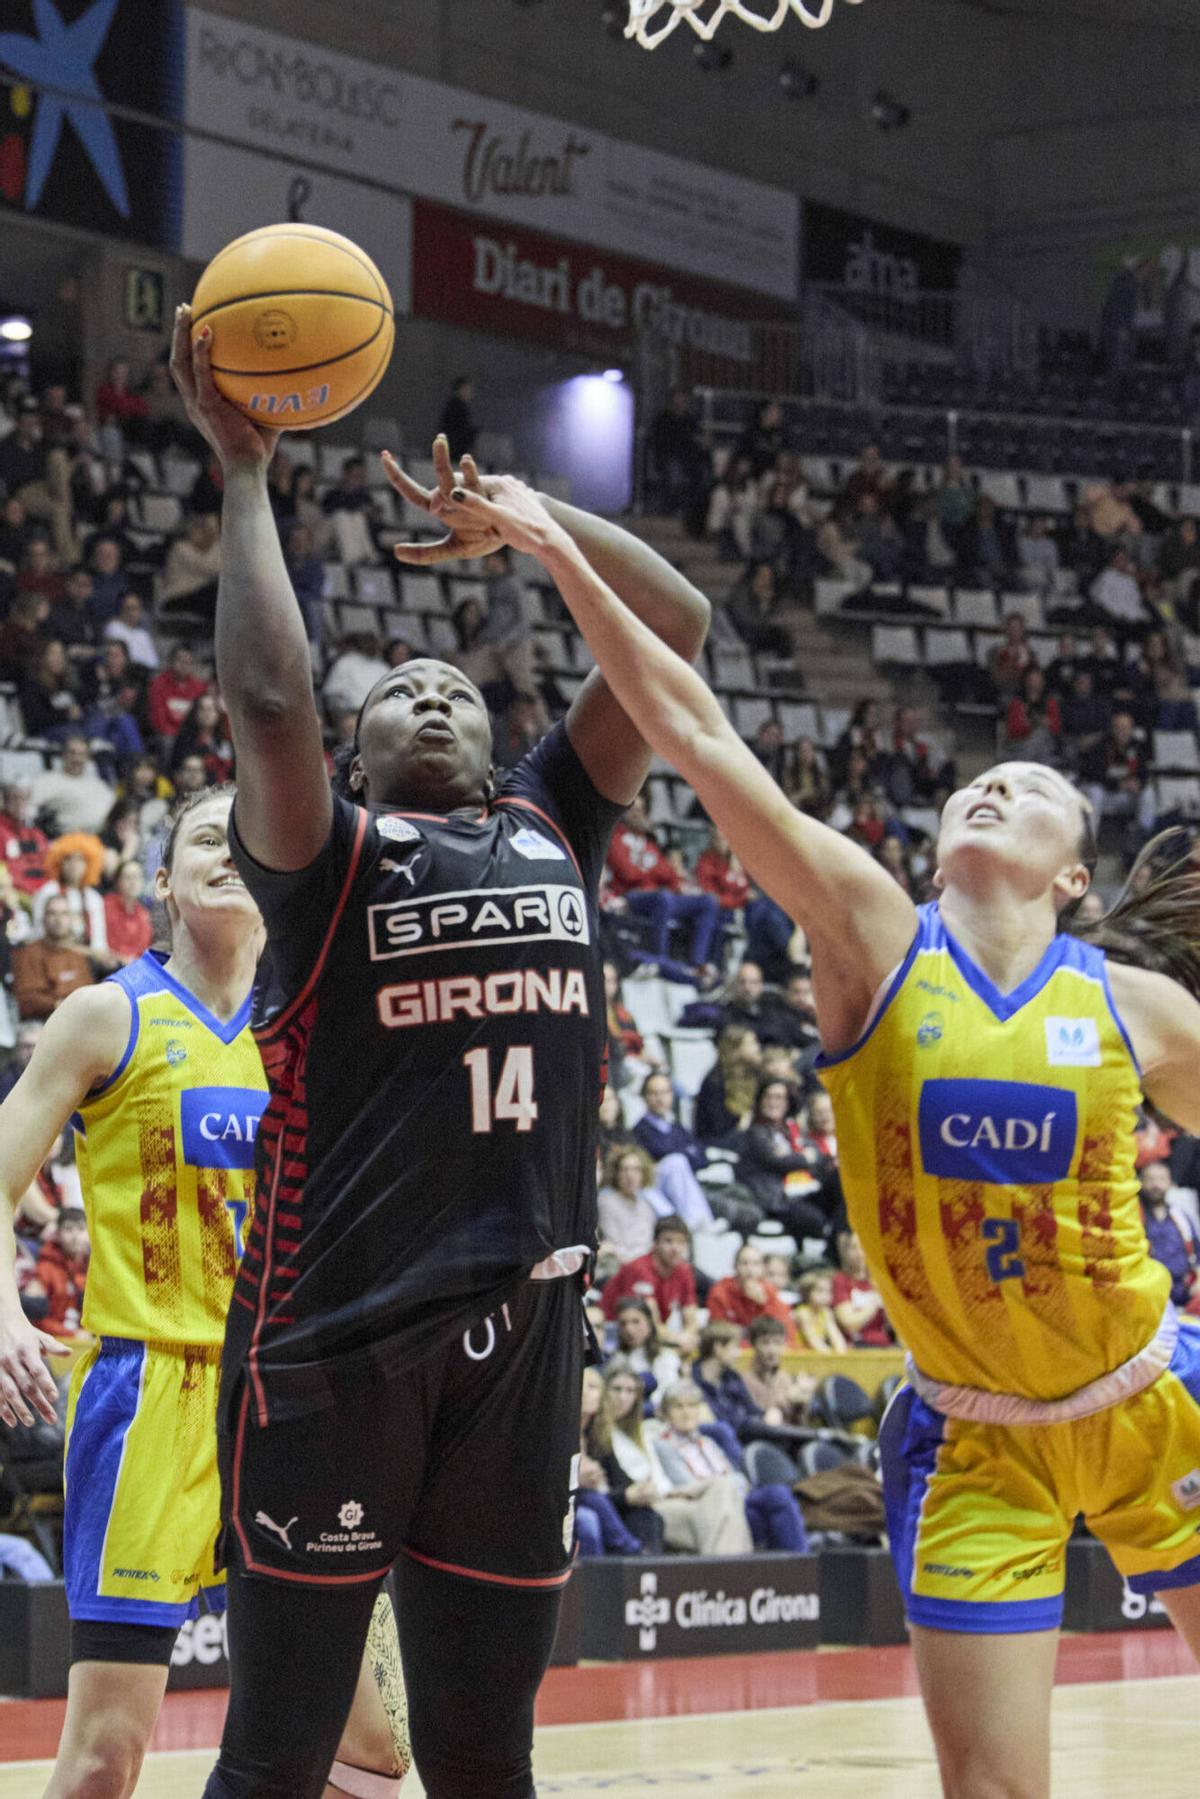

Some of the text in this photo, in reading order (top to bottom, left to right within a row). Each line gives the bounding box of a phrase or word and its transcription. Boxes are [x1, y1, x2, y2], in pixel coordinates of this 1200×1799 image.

[451, 118, 593, 202] Valent
[473, 238, 571, 313] Diari
[576, 266, 626, 328] de
[385, 896, 550, 945] SPAR
[376, 967, 591, 1028] GIRONA
[462, 1045, 539, 1133] 14
[939, 1111, 1057, 1152] CADÍ
[981, 1217, 1026, 1284] 2
[305, 1541, 383, 1553] Pirineu de Girona
[320, 1531, 376, 1542] Costa Brava
[675, 1586, 821, 1629] Clínica Girona
[169, 1612, 230, 1666] se
